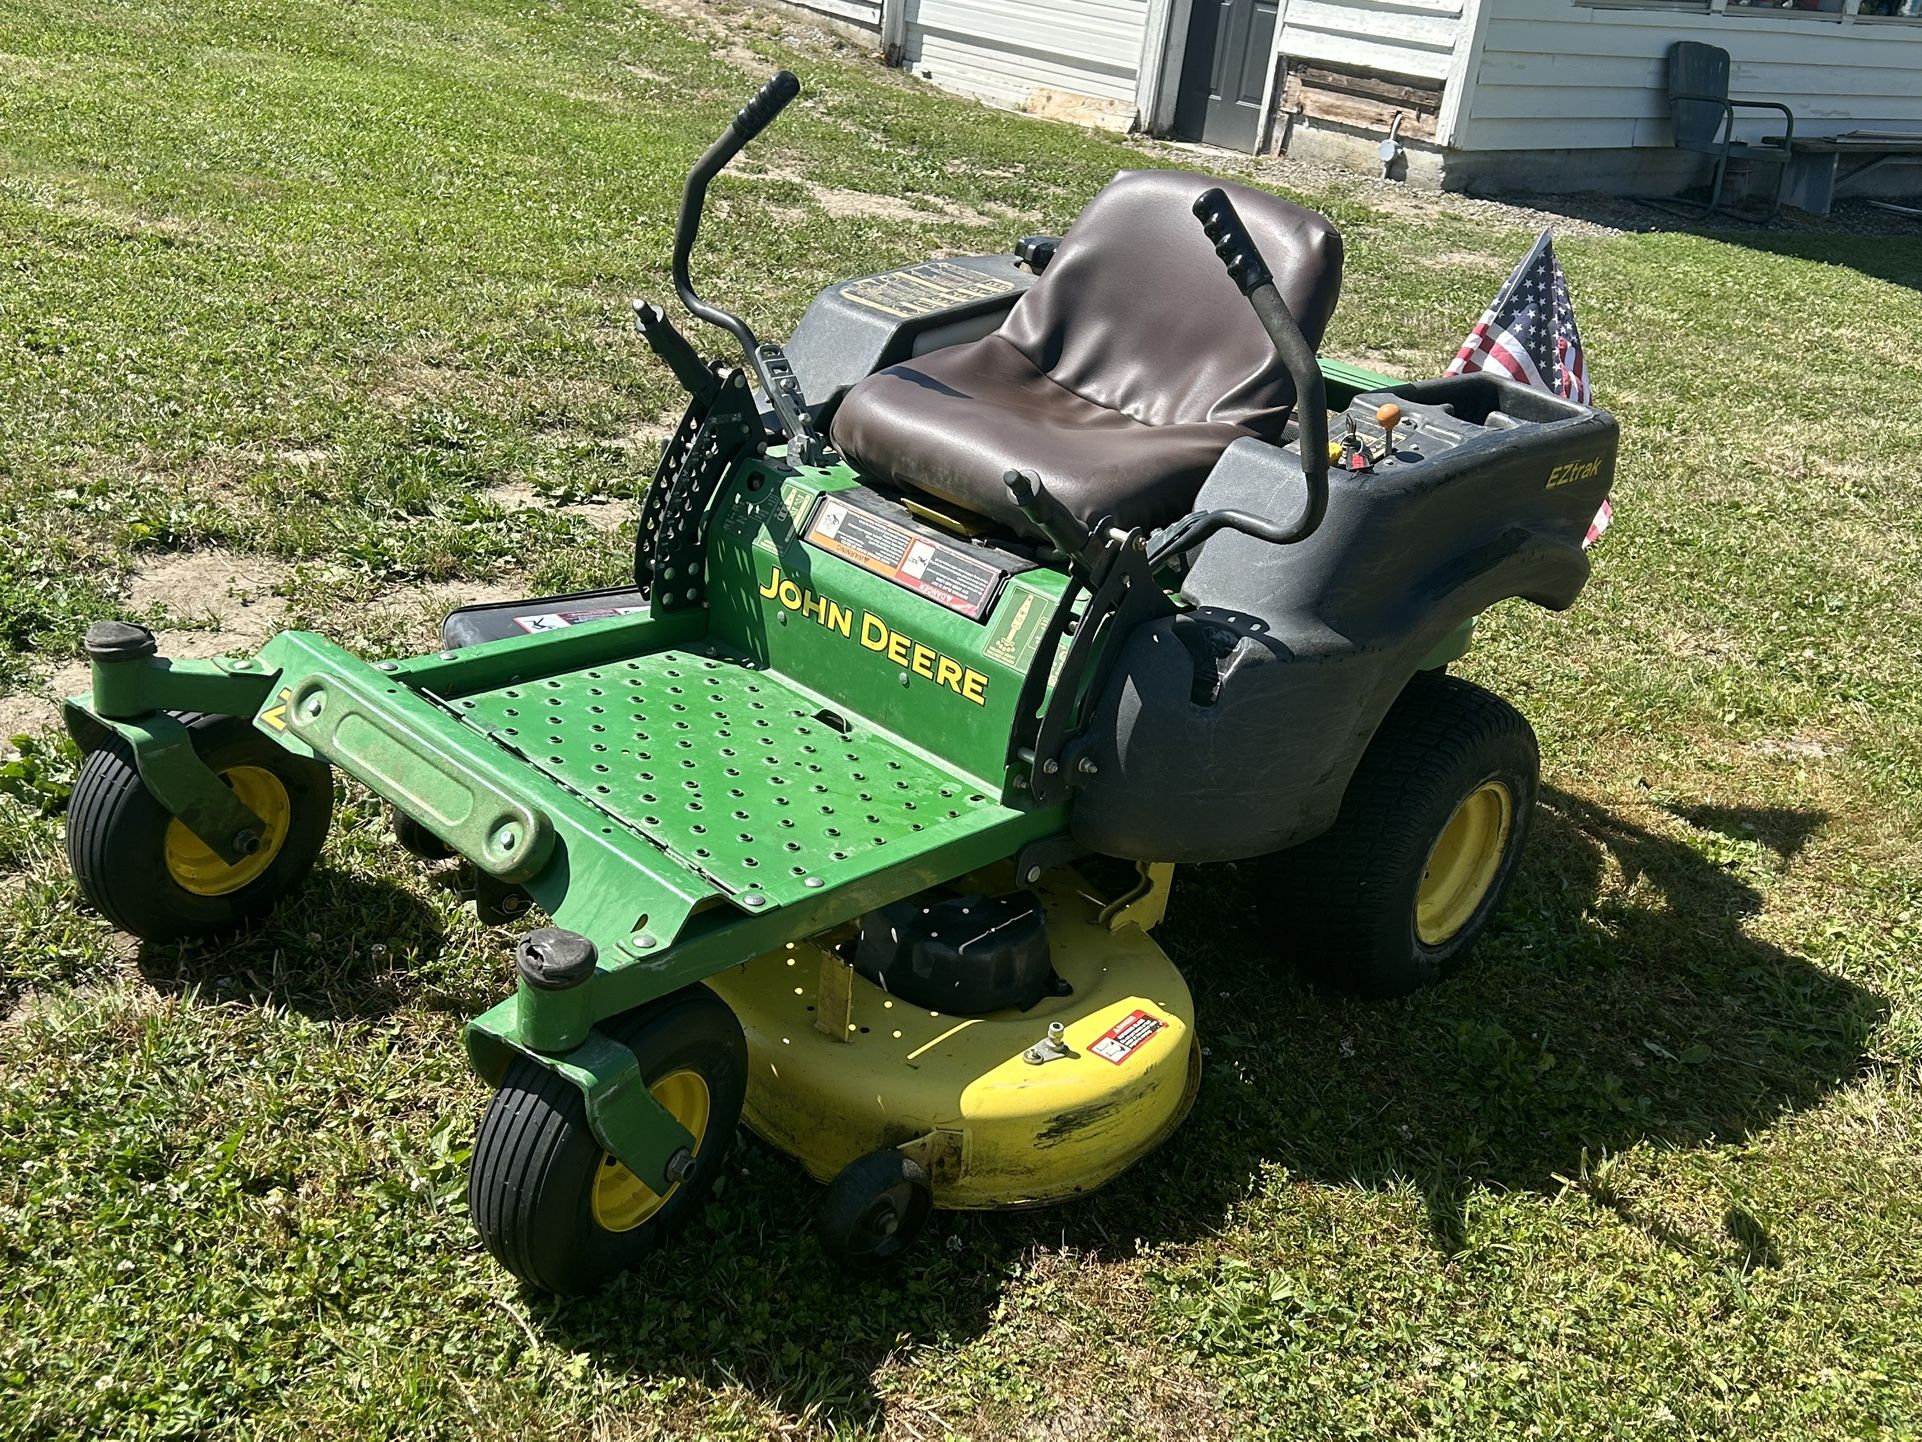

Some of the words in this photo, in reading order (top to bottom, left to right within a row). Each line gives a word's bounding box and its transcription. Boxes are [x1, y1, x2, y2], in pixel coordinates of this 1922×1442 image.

[1545, 456, 1602, 489] EZtrak
[836, 545, 868, 564] WARNING
[919, 580, 948, 601] DANGER
[759, 565, 853, 639] JOHN
[860, 610, 988, 706] DEERE
